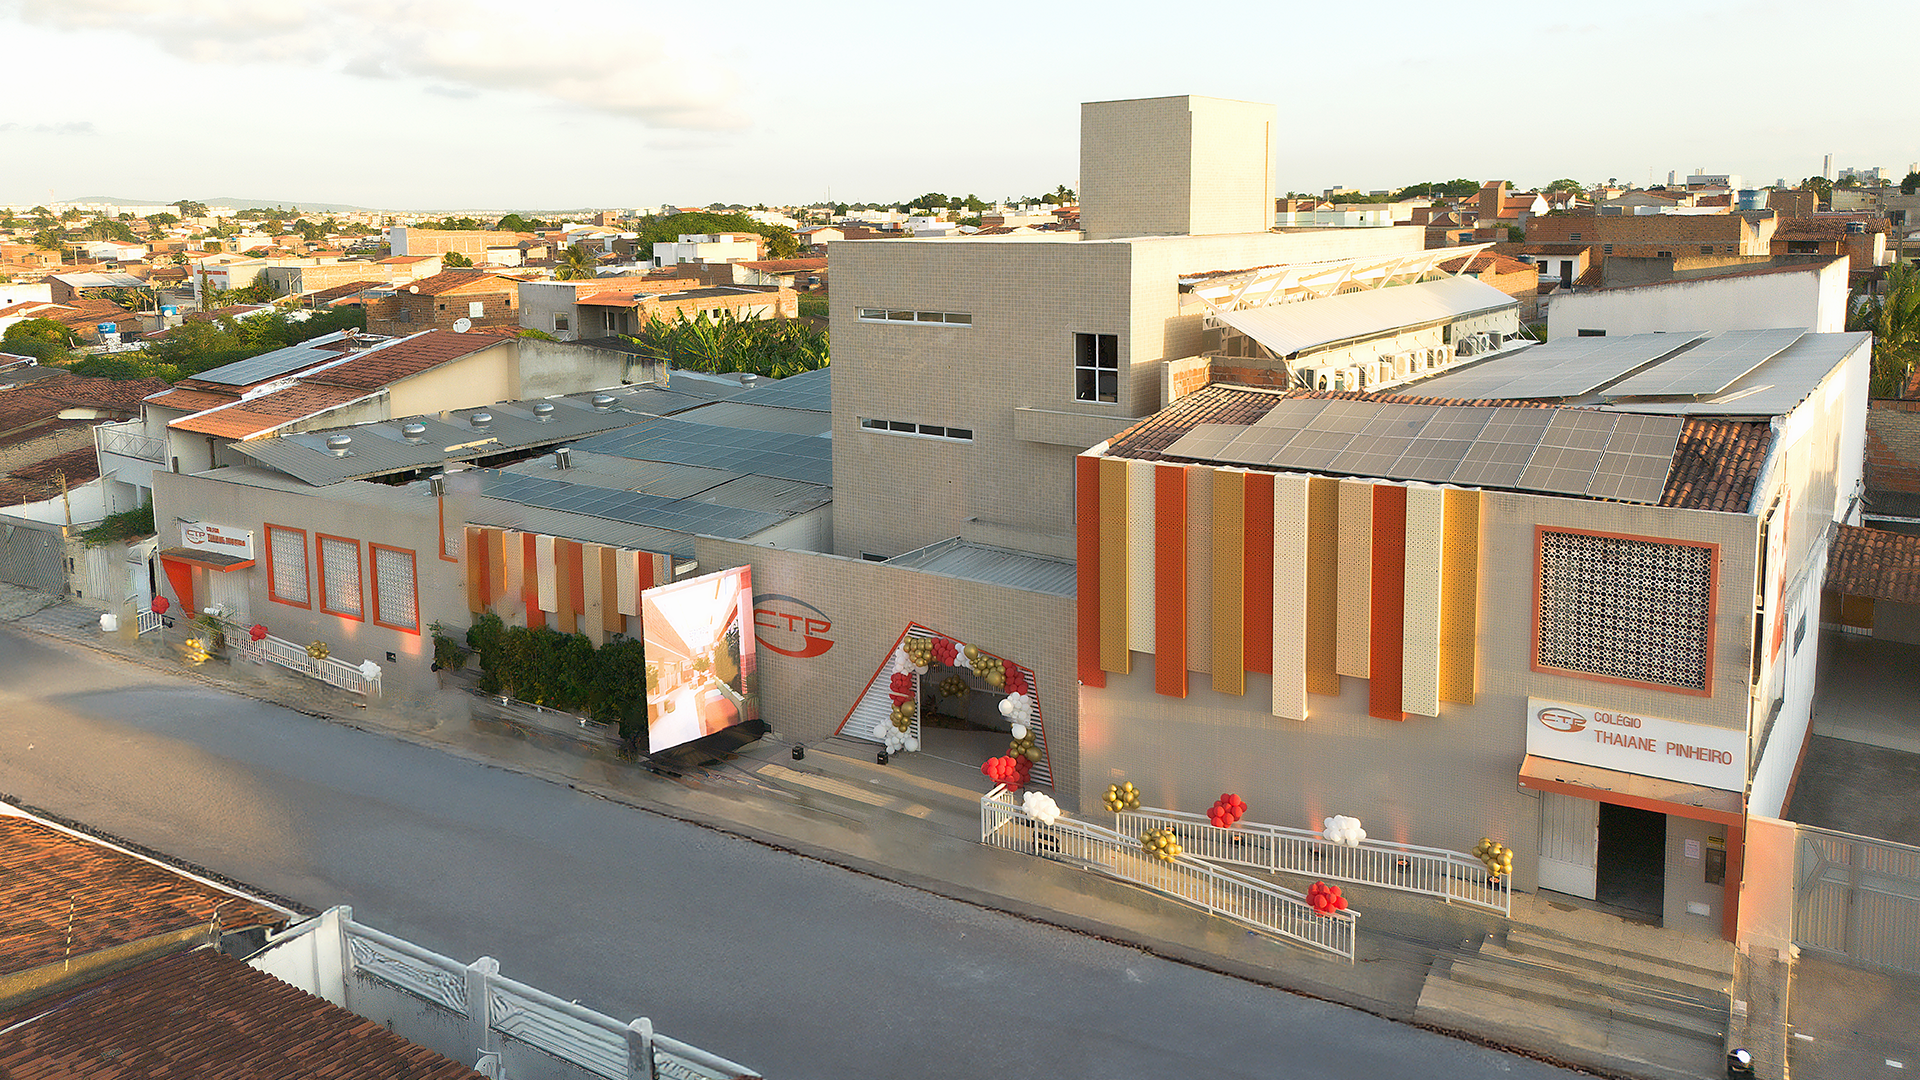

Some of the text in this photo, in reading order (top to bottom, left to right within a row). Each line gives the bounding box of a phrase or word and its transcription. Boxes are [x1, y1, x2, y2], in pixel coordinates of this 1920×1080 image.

[1594, 711, 1642, 729] COLÉGIO
[1594, 729, 1733, 765] THAIANE PINHEIRO
